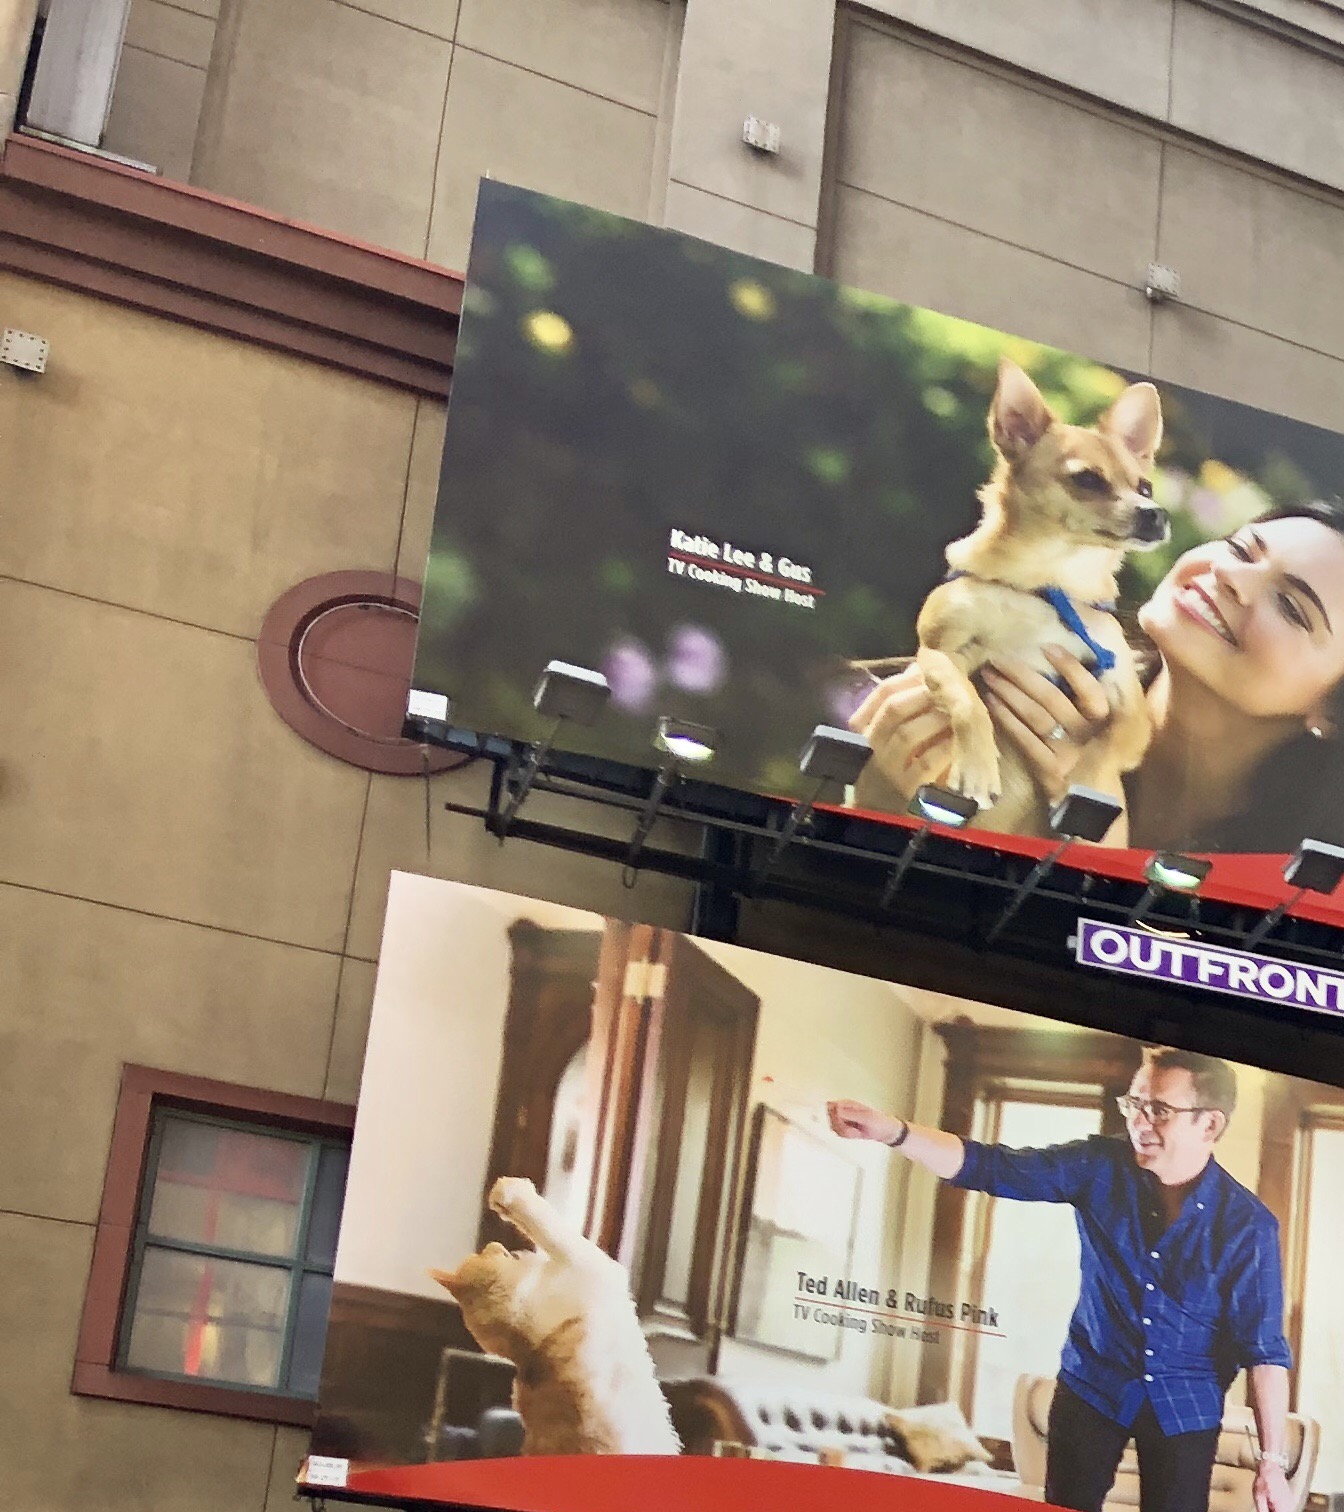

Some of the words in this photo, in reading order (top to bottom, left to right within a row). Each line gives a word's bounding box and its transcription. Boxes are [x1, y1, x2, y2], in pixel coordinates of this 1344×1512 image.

[793, 1304, 810, 1320] TV
[814, 1308, 867, 1333] Cooking
[871, 1318, 906, 1338] Show
[797, 1271, 827, 1295] Ted
[833, 1280, 879, 1305] Allen
[886, 1289, 898, 1308] &
[905, 1292, 954, 1319] Rufus
[960, 1303, 999, 1327] Pink
